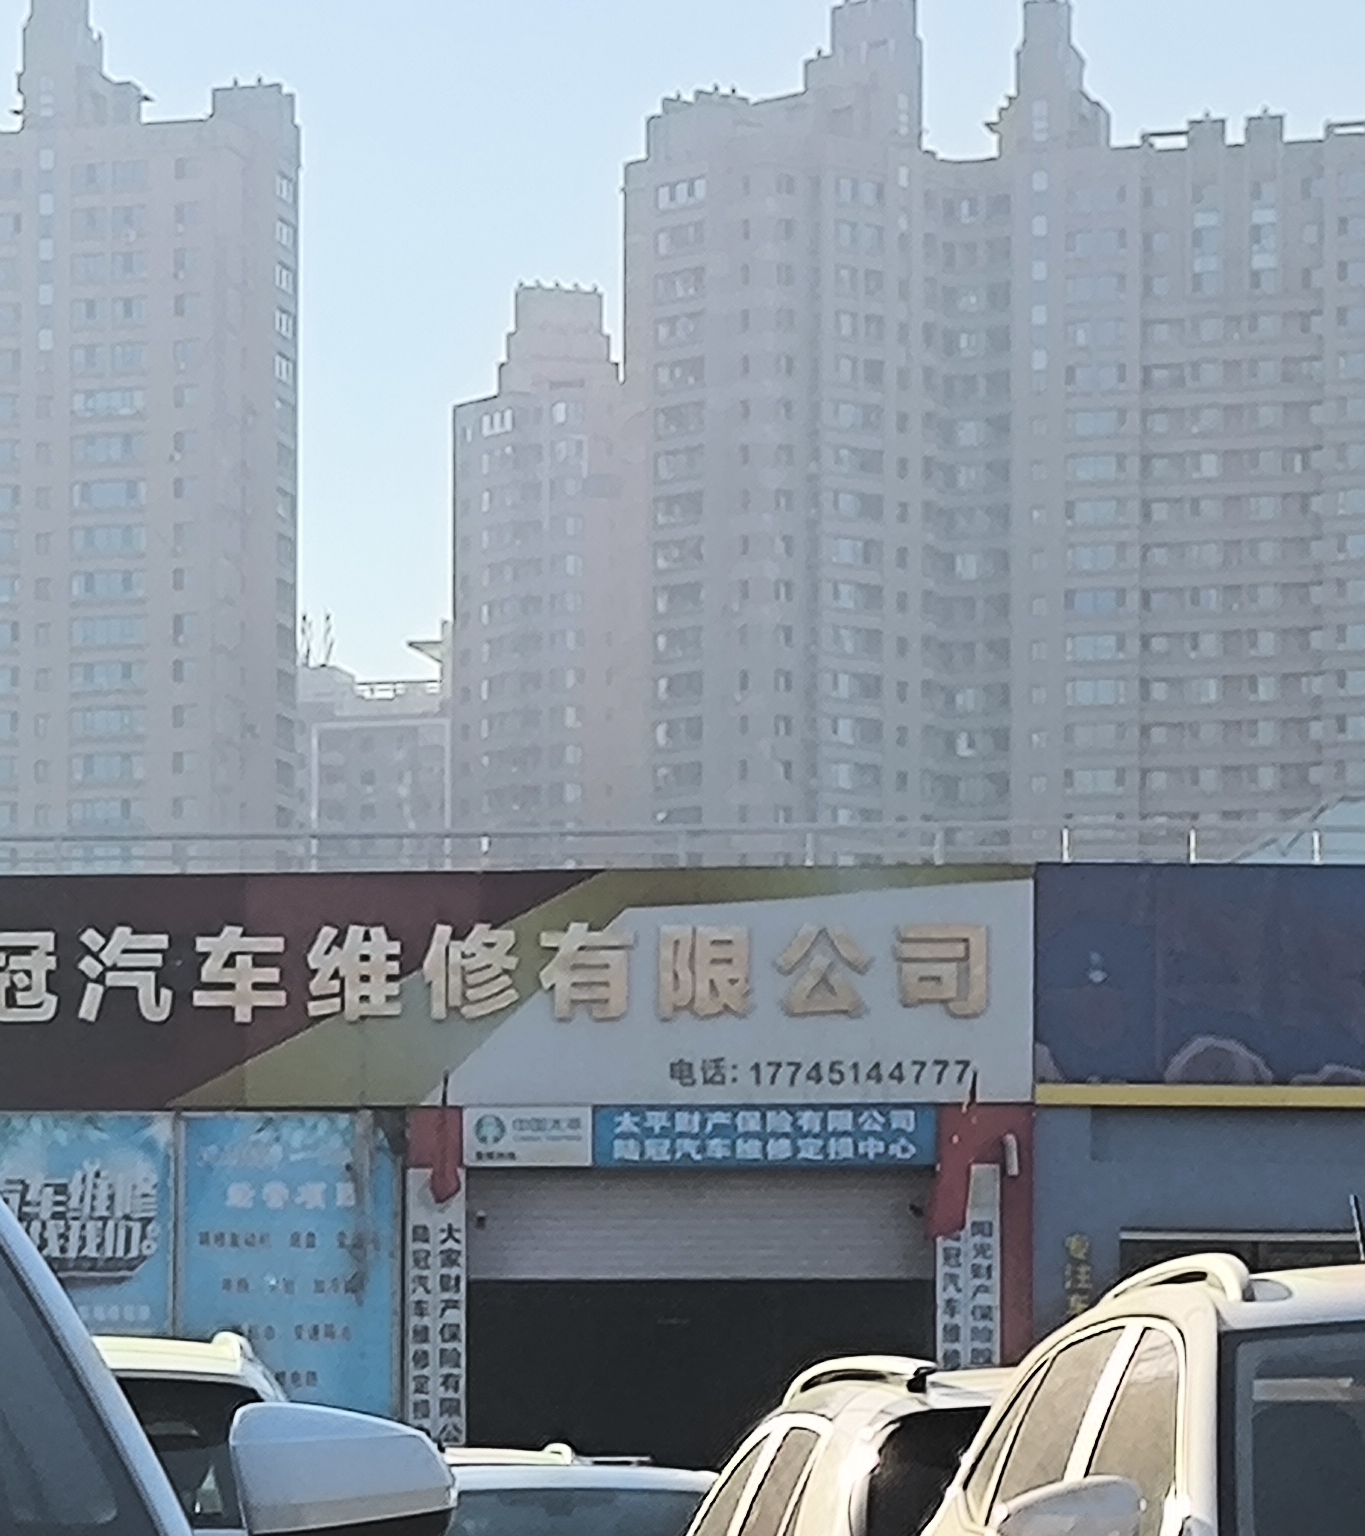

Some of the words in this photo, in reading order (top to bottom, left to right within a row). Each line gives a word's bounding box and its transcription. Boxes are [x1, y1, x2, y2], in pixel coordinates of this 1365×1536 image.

[613, 1109, 917, 1134] 太平财产保险有限公司
